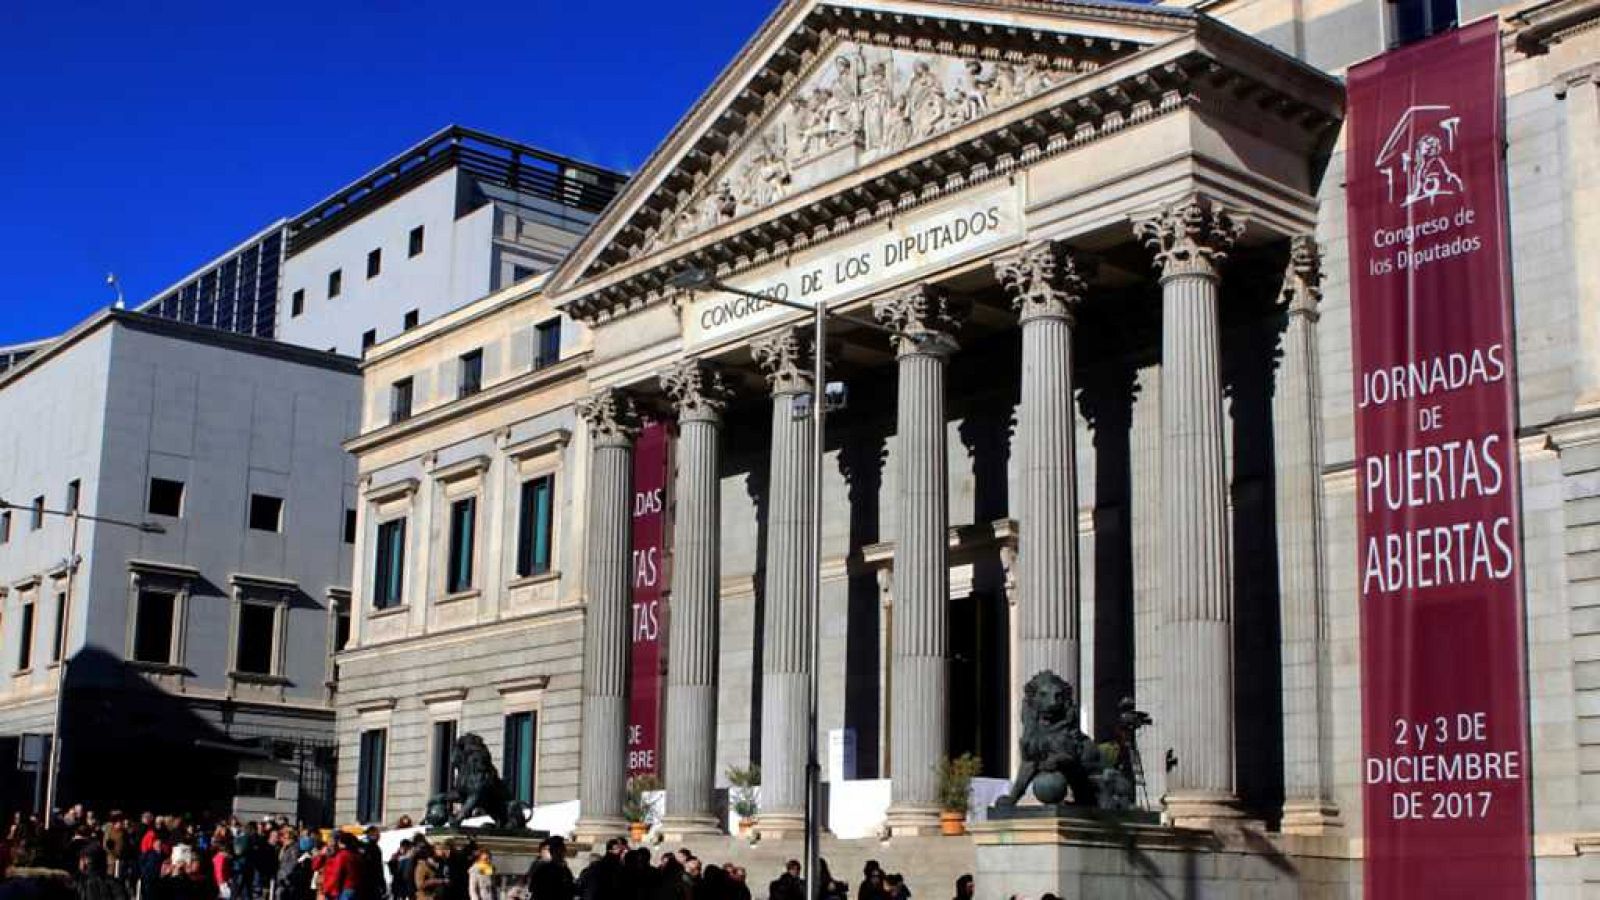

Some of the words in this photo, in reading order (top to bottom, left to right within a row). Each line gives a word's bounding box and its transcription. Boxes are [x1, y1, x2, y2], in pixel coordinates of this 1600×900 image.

[1374, 215, 1449, 247] Congreso
[1454, 206, 1475, 227] de
[700, 282, 788, 330] CONGRESO
[801, 269, 823, 297] DE
[835, 253, 871, 284] LOS
[884, 206, 999, 267] DIPUTADOS
[1369, 257, 1393, 276] los
[1397, 235, 1481, 270] Diputados
[1358, 344, 1505, 409] JORNADAS
[1419, 405, 1443, 432] DE
[1366, 434, 1503, 513] PUERTAS
[633, 488, 662, 517] DAS
[1363, 516, 1513, 595] ABIERTAS
[1394, 718, 1409, 745] 2
[1415, 723, 1429, 751] y
[1435, 716, 1449, 743] 3
[1457, 711, 1487, 742] DE
[1366, 750, 1520, 784] DICIEMBRE
[1393, 791, 1425, 820] DE
[1431, 791, 1493, 819] 2017
